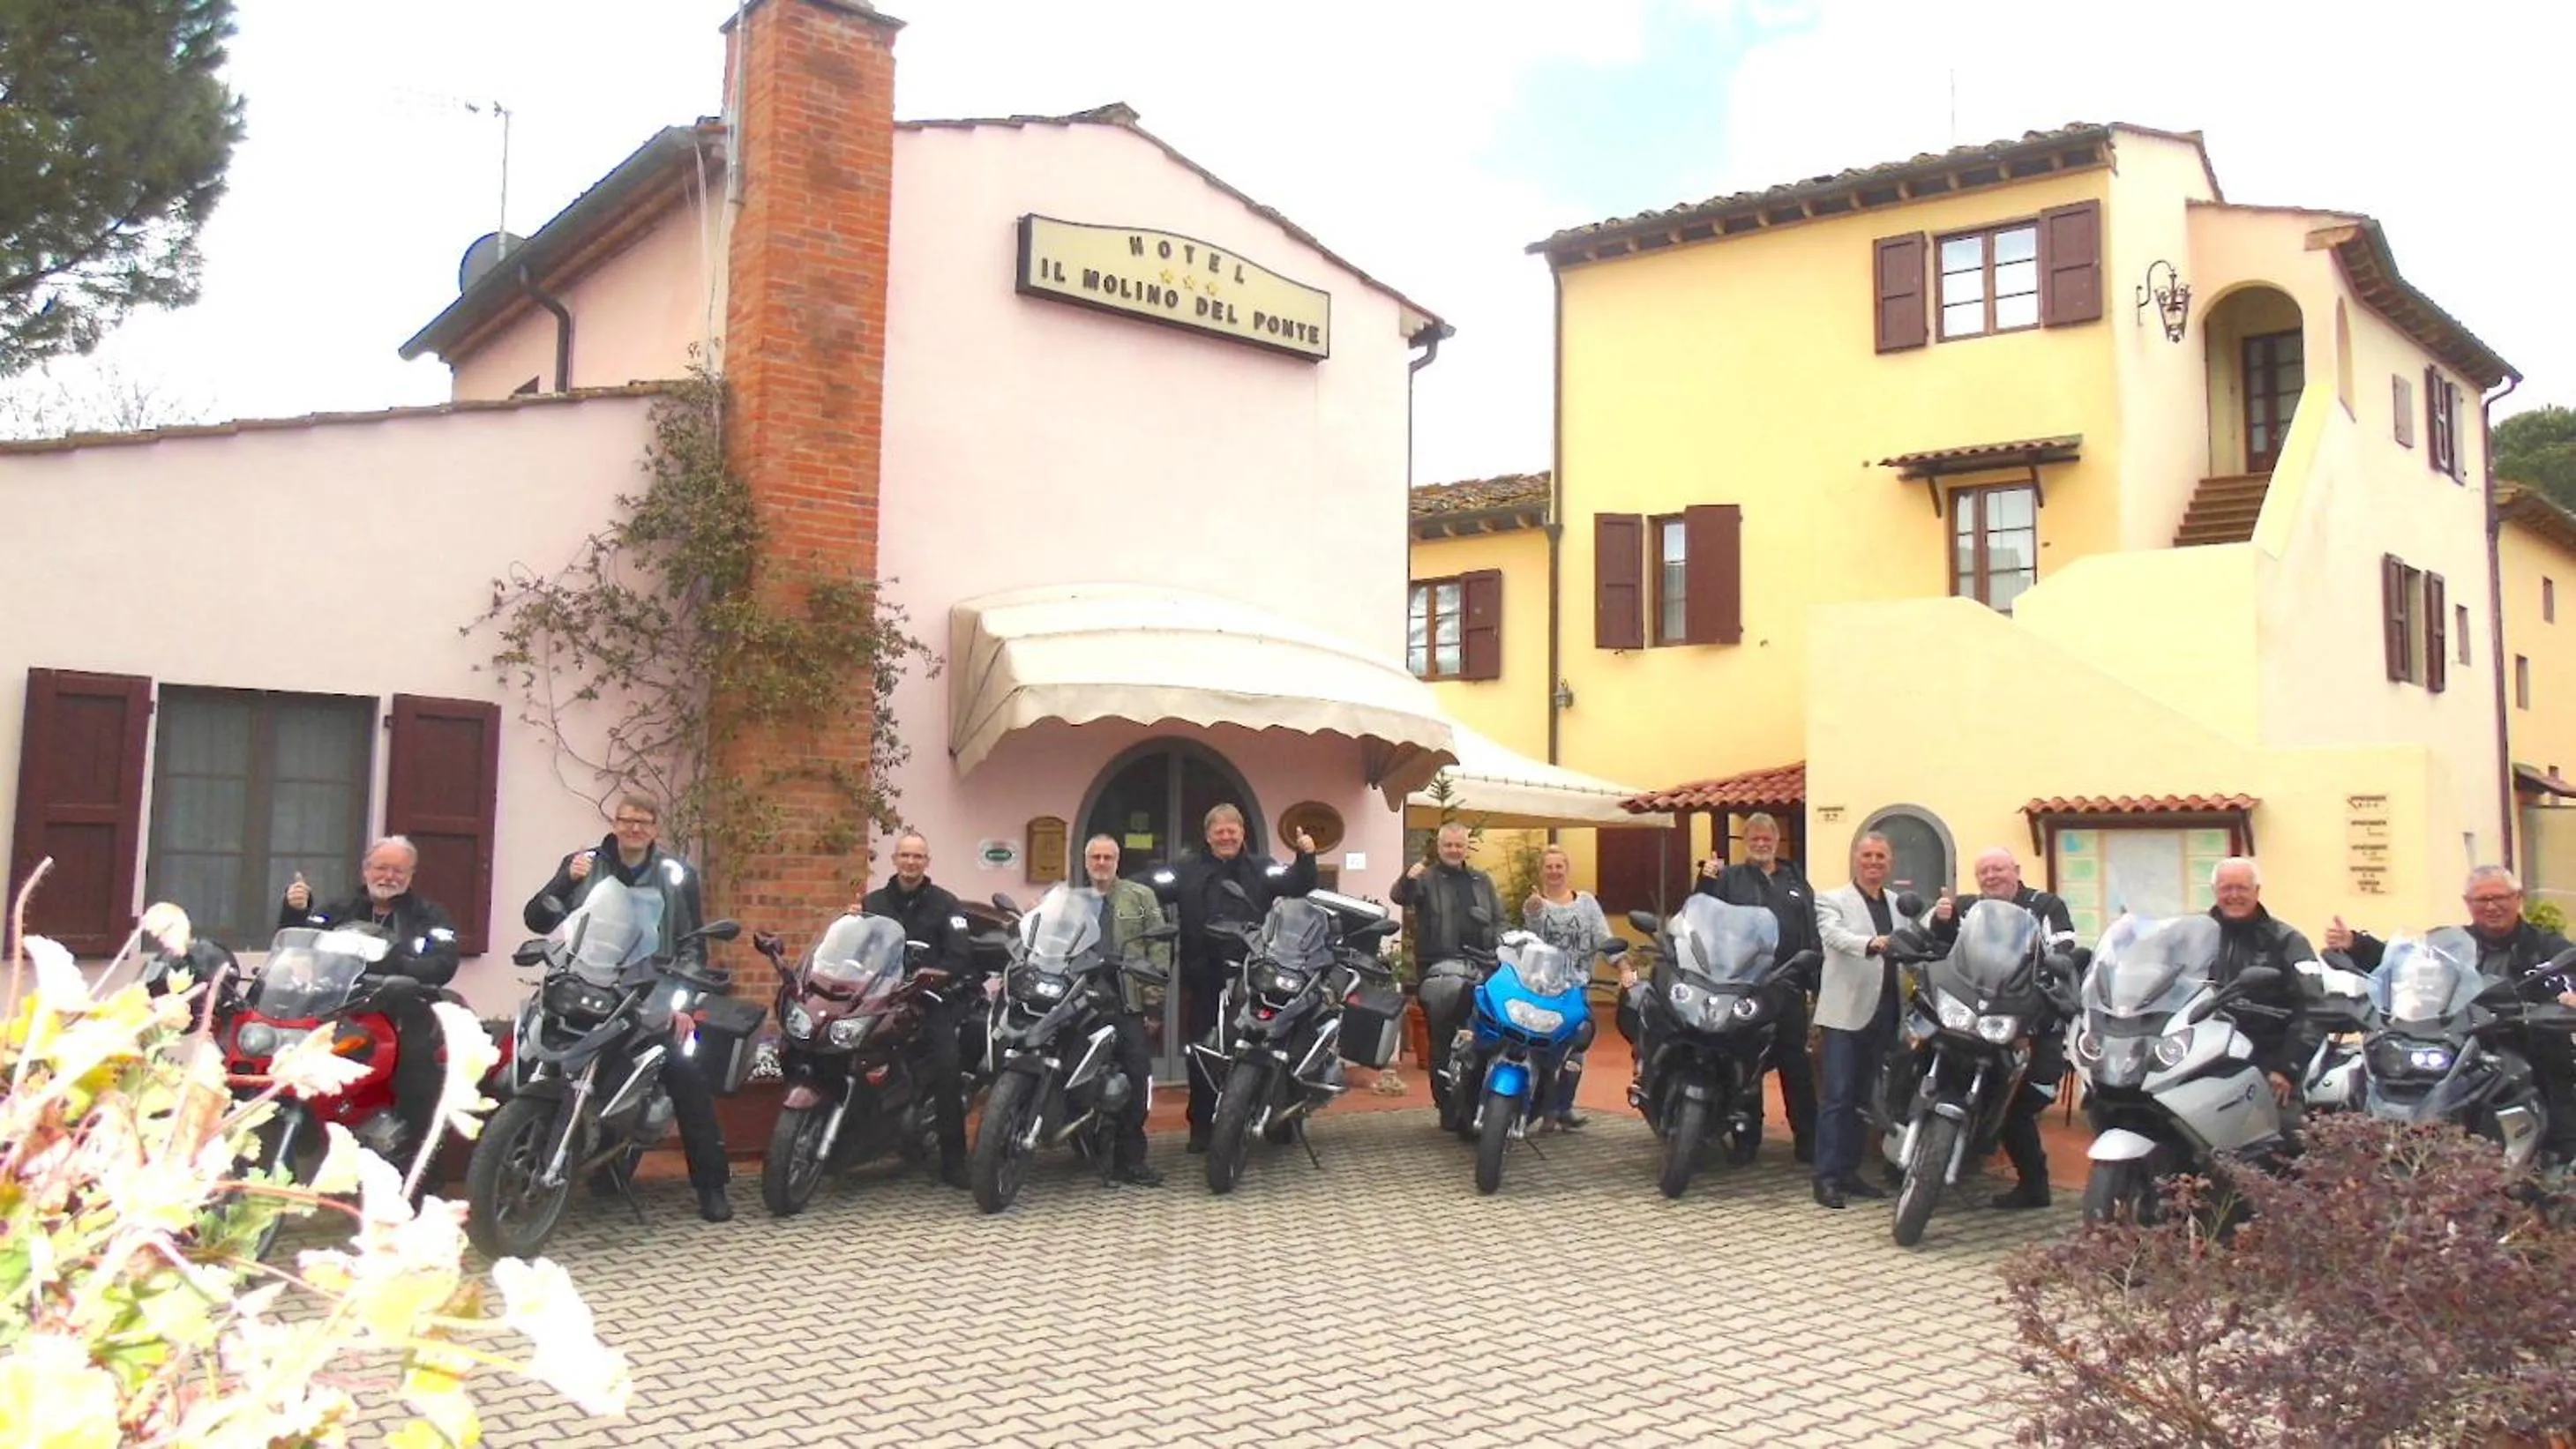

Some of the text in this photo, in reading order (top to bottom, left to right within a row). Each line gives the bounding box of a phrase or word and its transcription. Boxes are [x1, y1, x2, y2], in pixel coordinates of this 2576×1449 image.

[1129, 235, 1245, 284] HOTEL
[1041, 258, 1320, 345] IL MOLINO DEL PONTE
